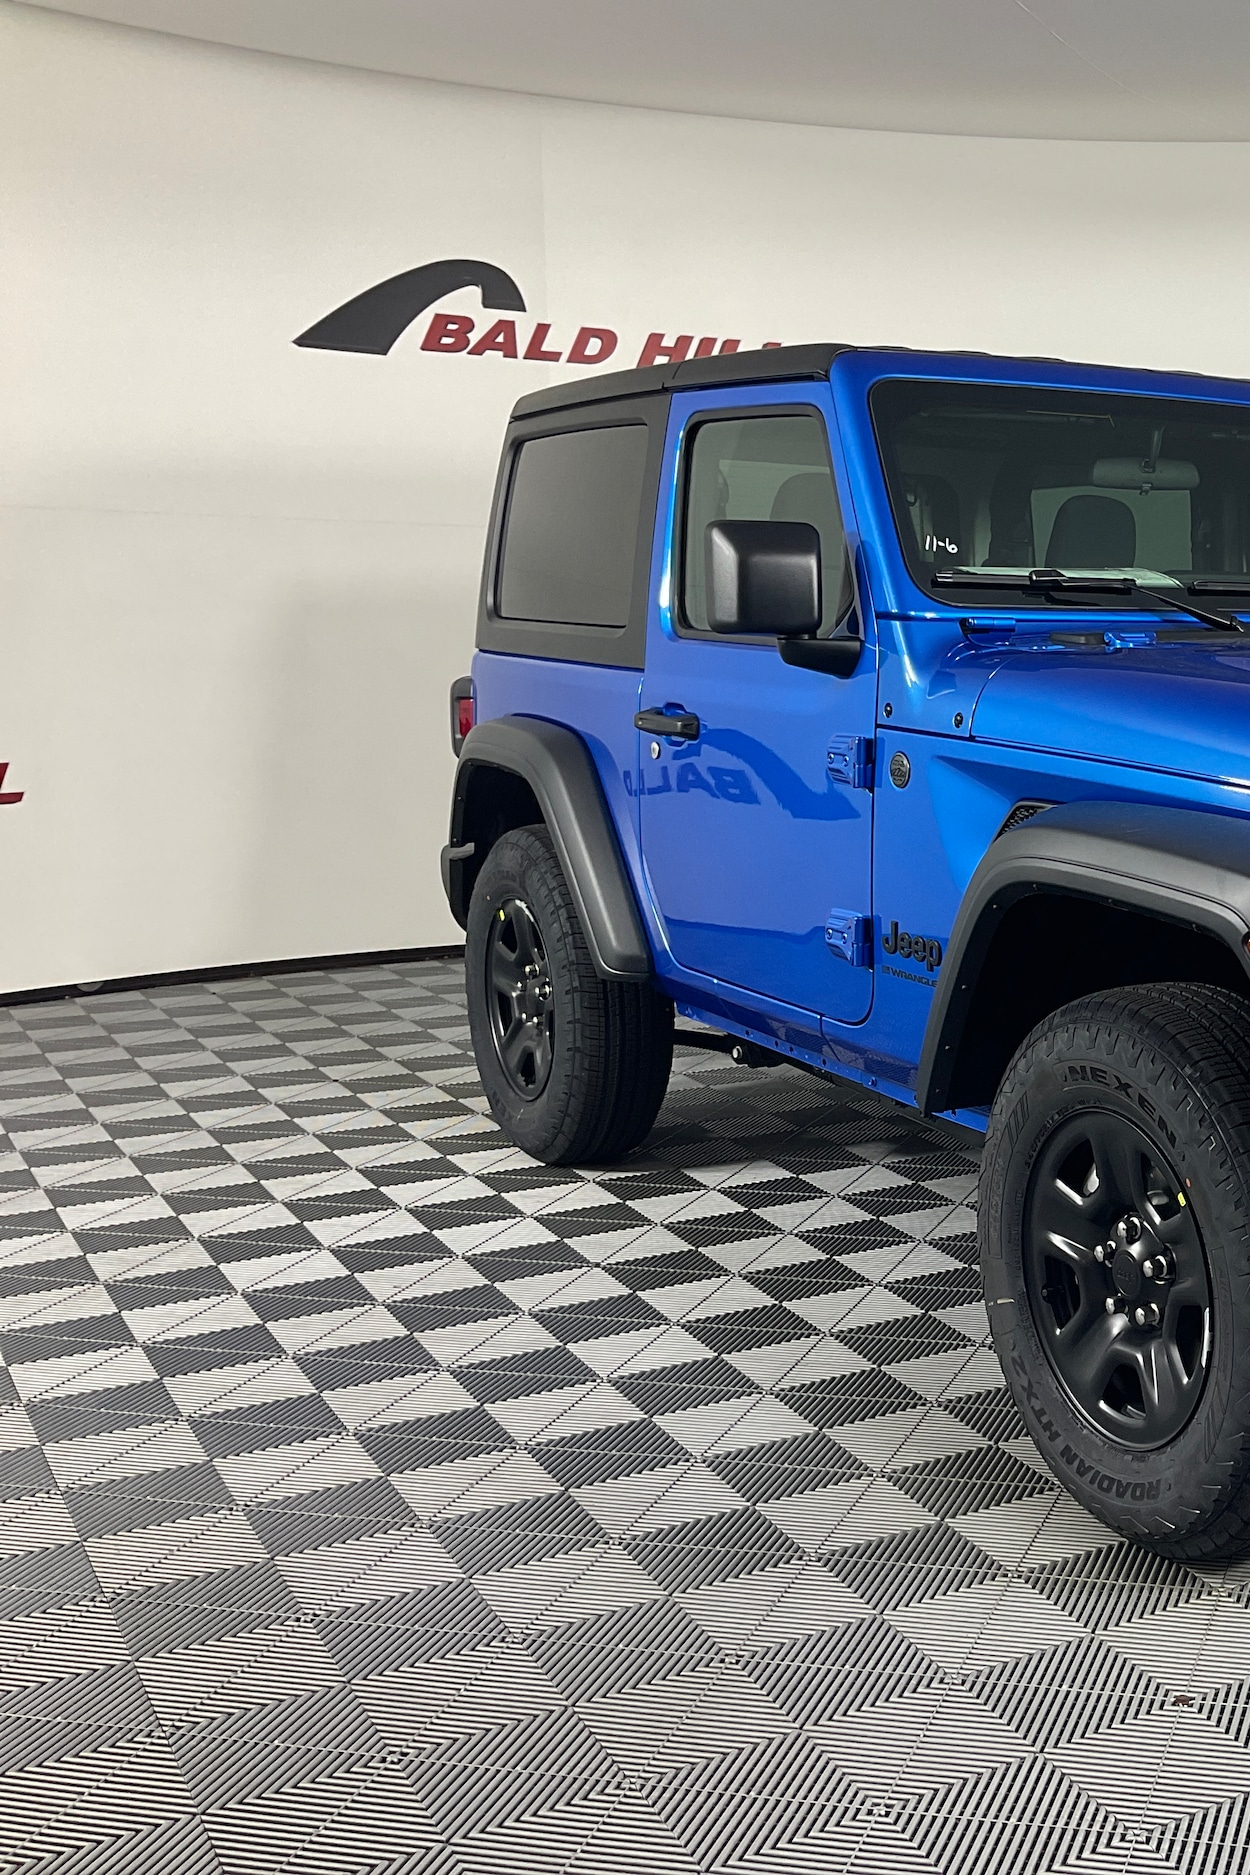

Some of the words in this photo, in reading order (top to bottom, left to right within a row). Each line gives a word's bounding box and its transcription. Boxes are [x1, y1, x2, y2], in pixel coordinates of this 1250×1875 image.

[420, 312, 618, 365] BALD
[925, 534, 959, 554] 11-6
[882, 920, 943, 973] Jeep
[890, 966, 939, 988] WRANGLE
[1067, 1065, 1177, 1149] NEXEN
[1059, 1443, 1162, 1501] ROADIAN
